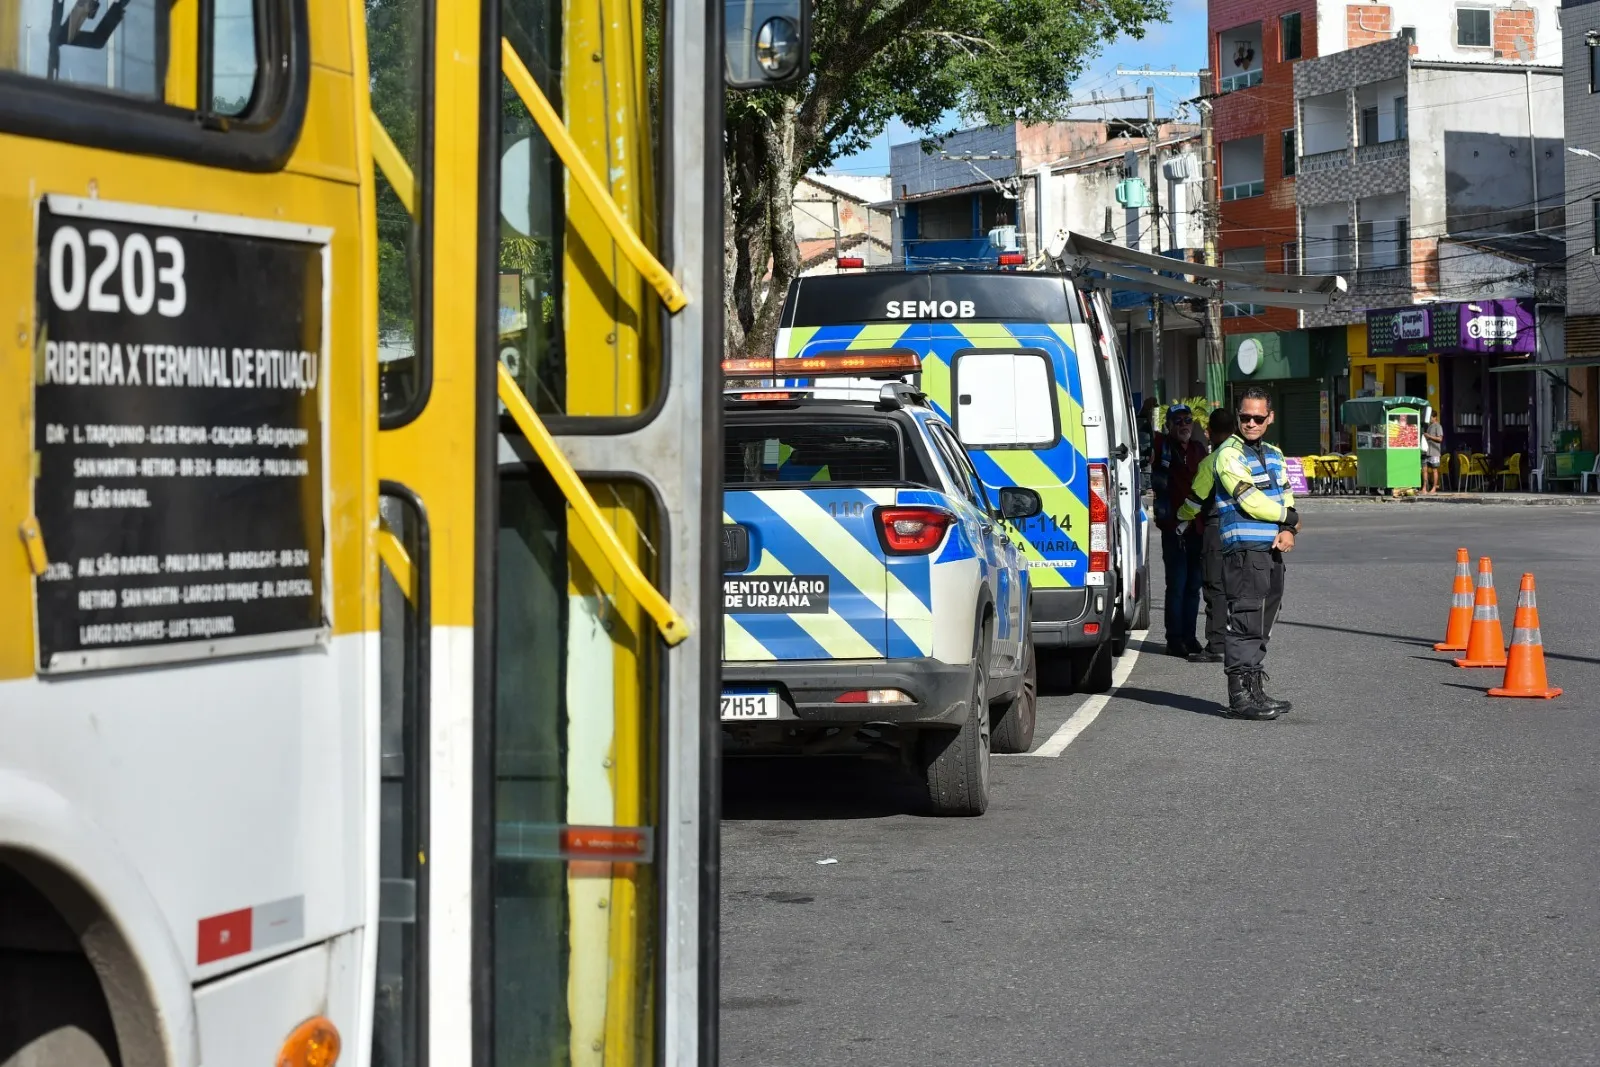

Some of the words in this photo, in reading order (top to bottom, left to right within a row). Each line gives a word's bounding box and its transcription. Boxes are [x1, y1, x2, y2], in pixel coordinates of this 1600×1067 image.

[49, 226, 187, 317] 0203
[886, 300, 976, 319] SEMOB
[1485, 329, 1512, 337] house
[45, 341, 125, 385] RIBEIRA
[126, 344, 141, 386] X
[142, 345, 231, 388] TERMINAL
[232, 348, 254, 388] DE
[255, 349, 318, 396] PITUAÇU
[1031, 537, 1080, 553] VIÁRIA
[773, 577, 825, 594] VIÁRIO
[747, 595, 811, 607] URBANA
[721, 697, 767, 716] 7H51
